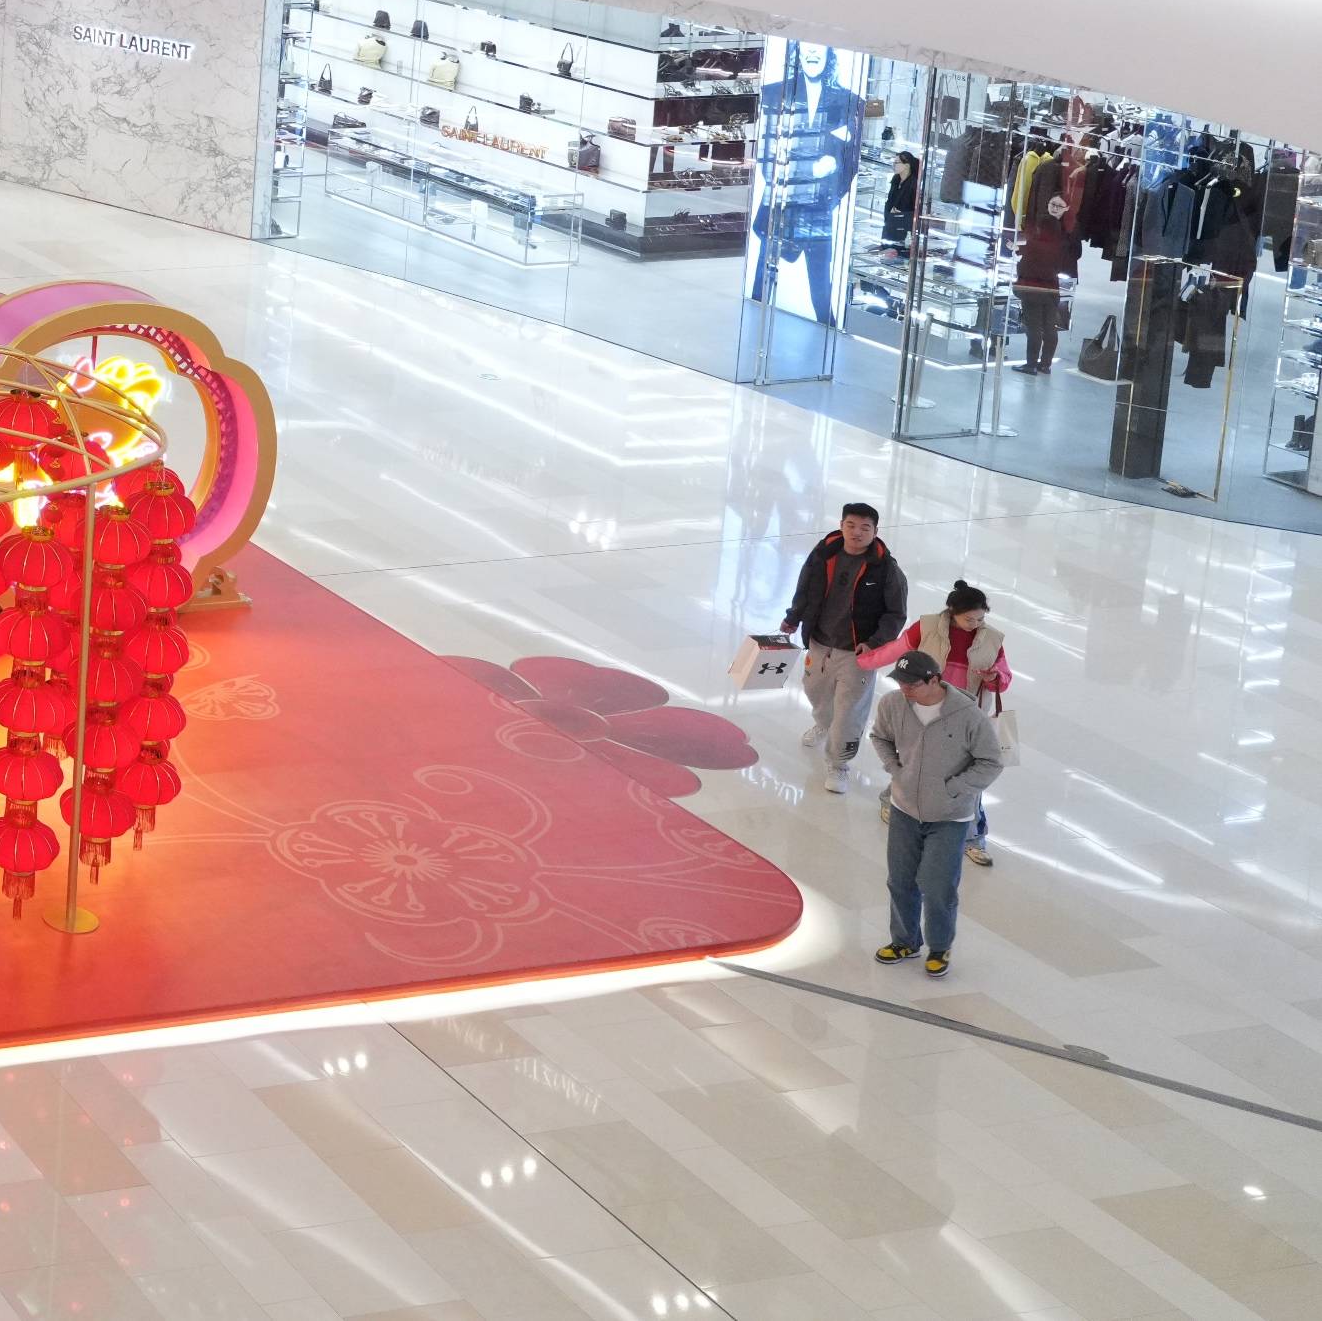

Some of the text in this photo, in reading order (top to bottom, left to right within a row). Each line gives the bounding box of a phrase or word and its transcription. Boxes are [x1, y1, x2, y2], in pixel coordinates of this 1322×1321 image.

[73, 25, 192, 59] SAINT LAURENT
[441, 125, 549, 159] SAINT LAURENT
